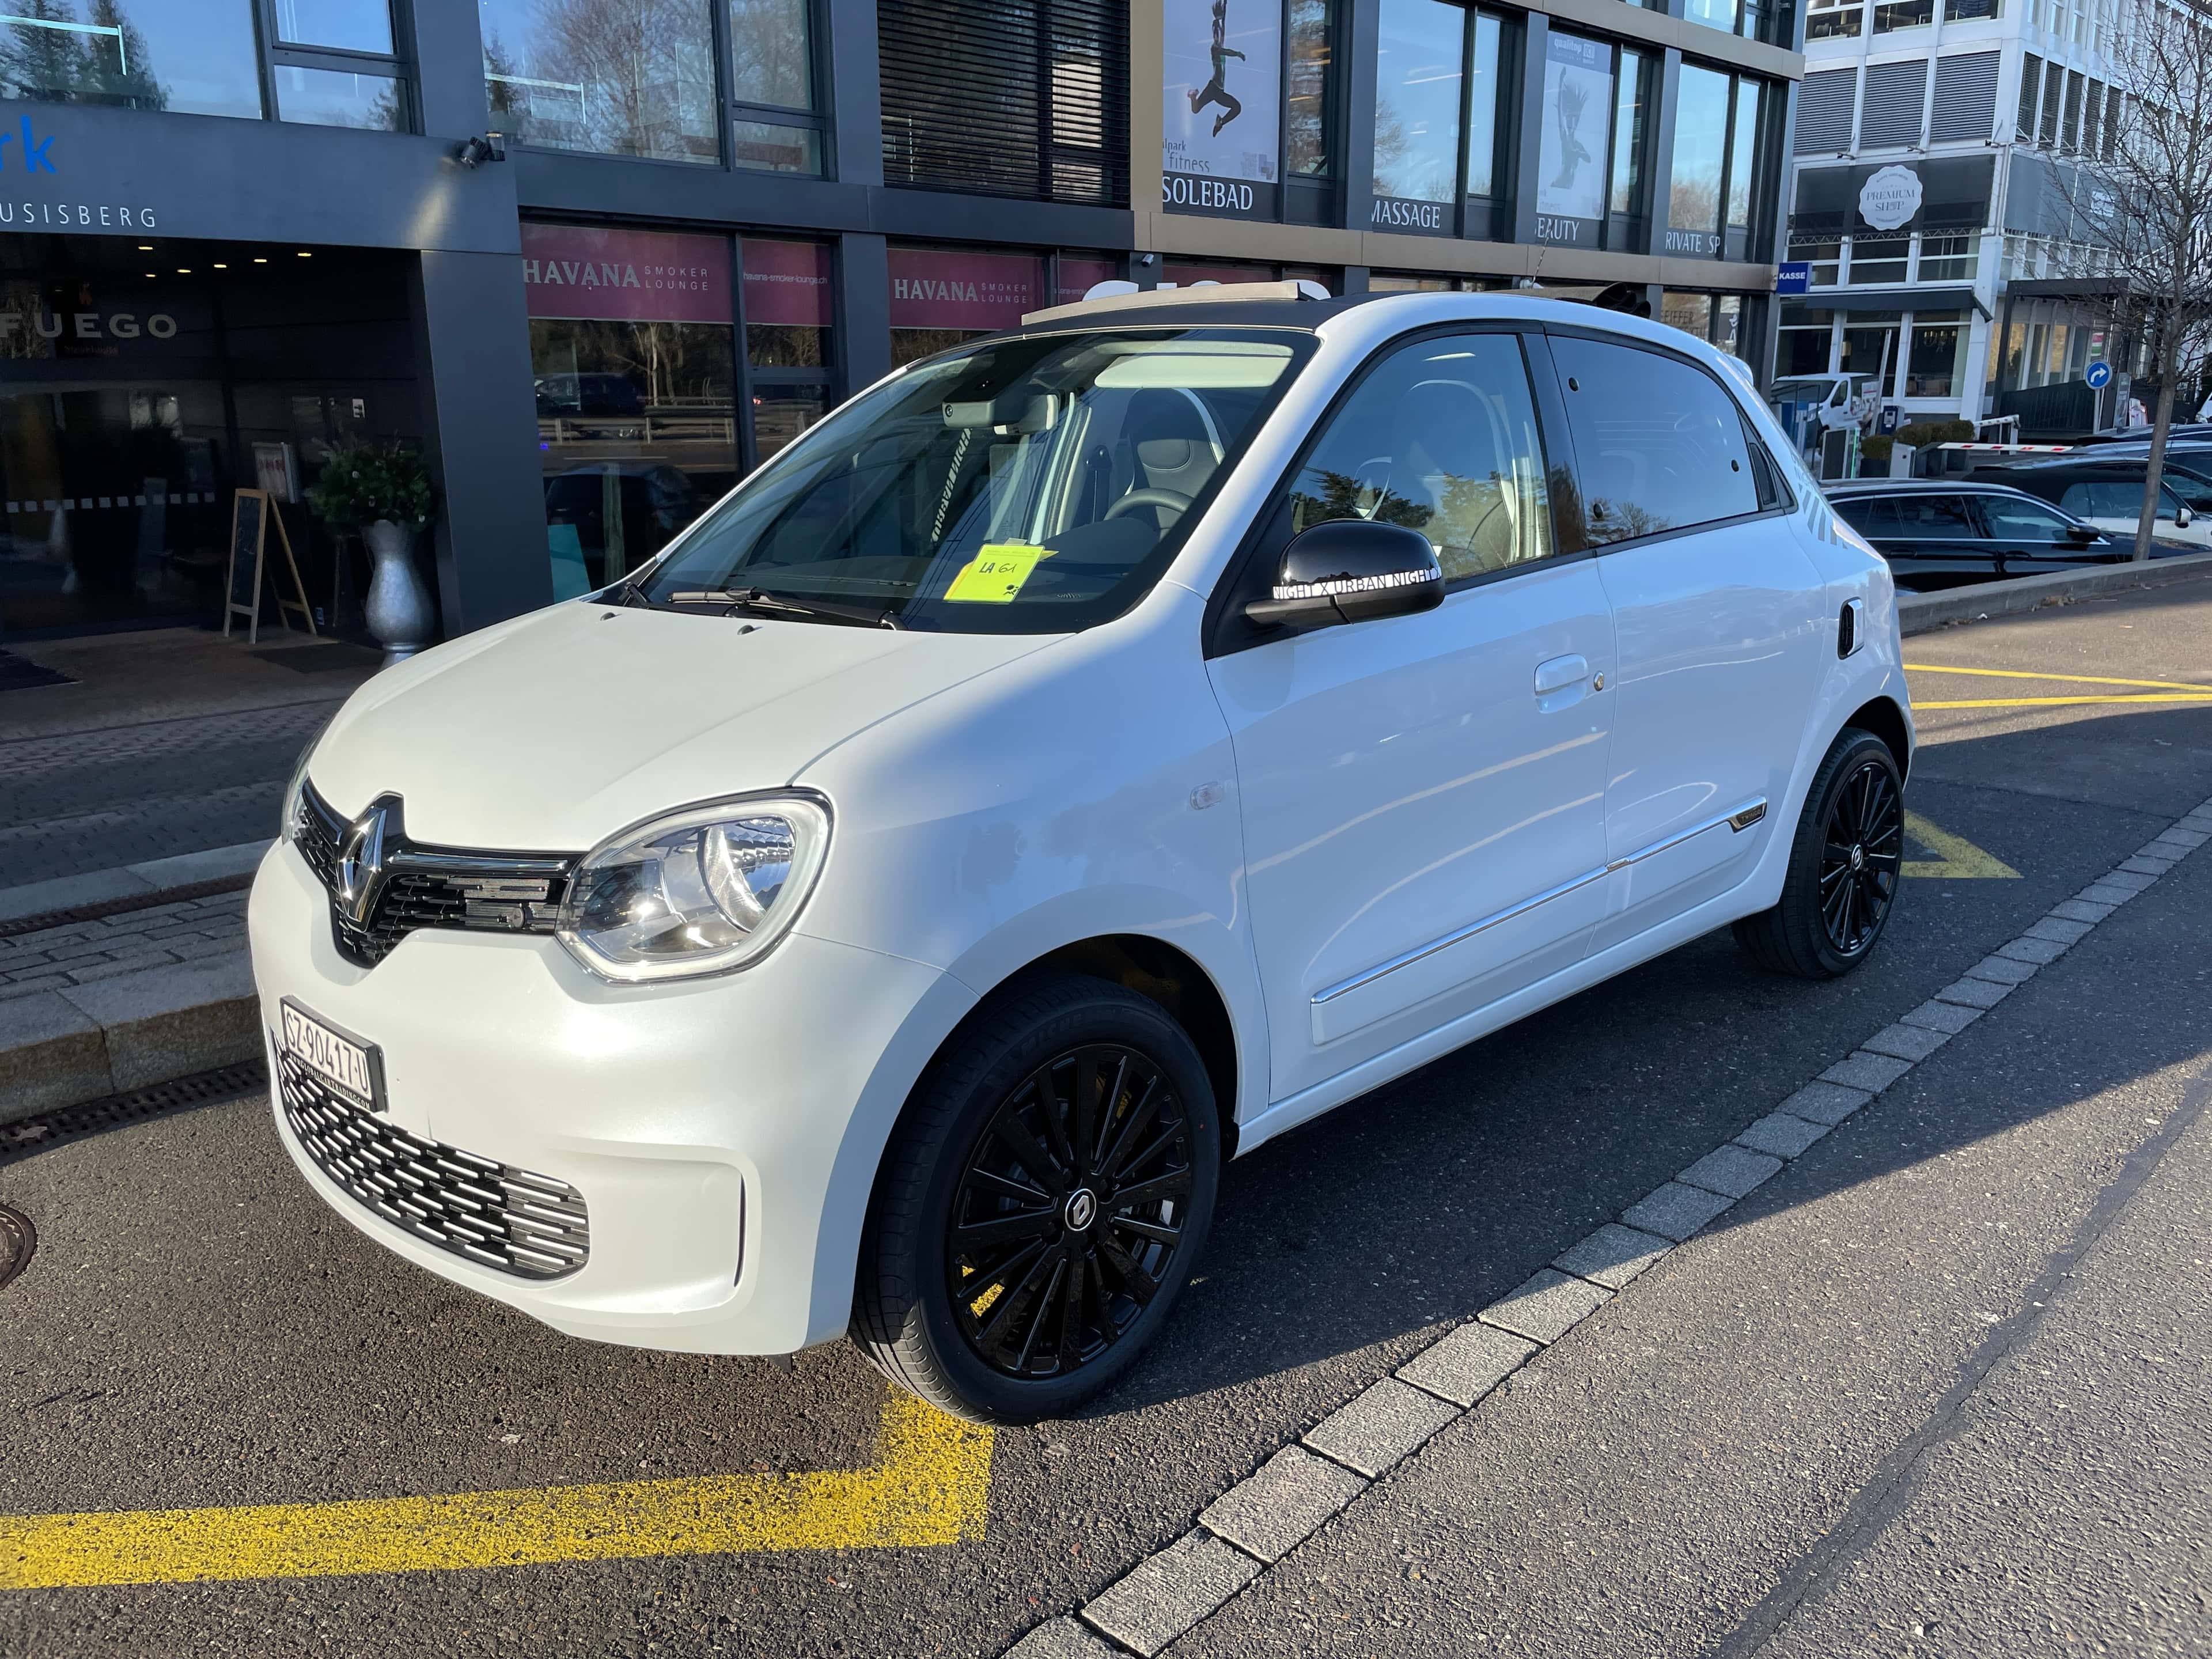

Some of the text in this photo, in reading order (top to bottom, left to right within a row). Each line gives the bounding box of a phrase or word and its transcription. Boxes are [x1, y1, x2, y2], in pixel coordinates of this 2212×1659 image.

[1169, 152, 1210, 172] fitness
[1162, 176, 1253, 210] SOLEBAD
[1866, 190, 1914, 201] PREMIUM
[0, 203, 155, 228] USISBERG
[1535, 217, 1580, 241] EAUTY
[1665, 232, 1728, 254] RIVATE SP
[522, 259, 641, 287] HAVANA
[645, 266, 708, 277] SMOKER
[1779, 272, 1806, 280] KASSE
[645, 280, 708, 291] LOUNGE
[894, 279, 978, 302] HAVANA
[982, 282, 1028, 292] SMOKER
[982, 294, 1028, 304] LOUNGE
[0, 313, 177, 339] FUEGO
[979, 562, 995, 574] LA
[1274, 584, 1314, 600] NIGHT
[1335, 575, 1386, 594] URBAN
